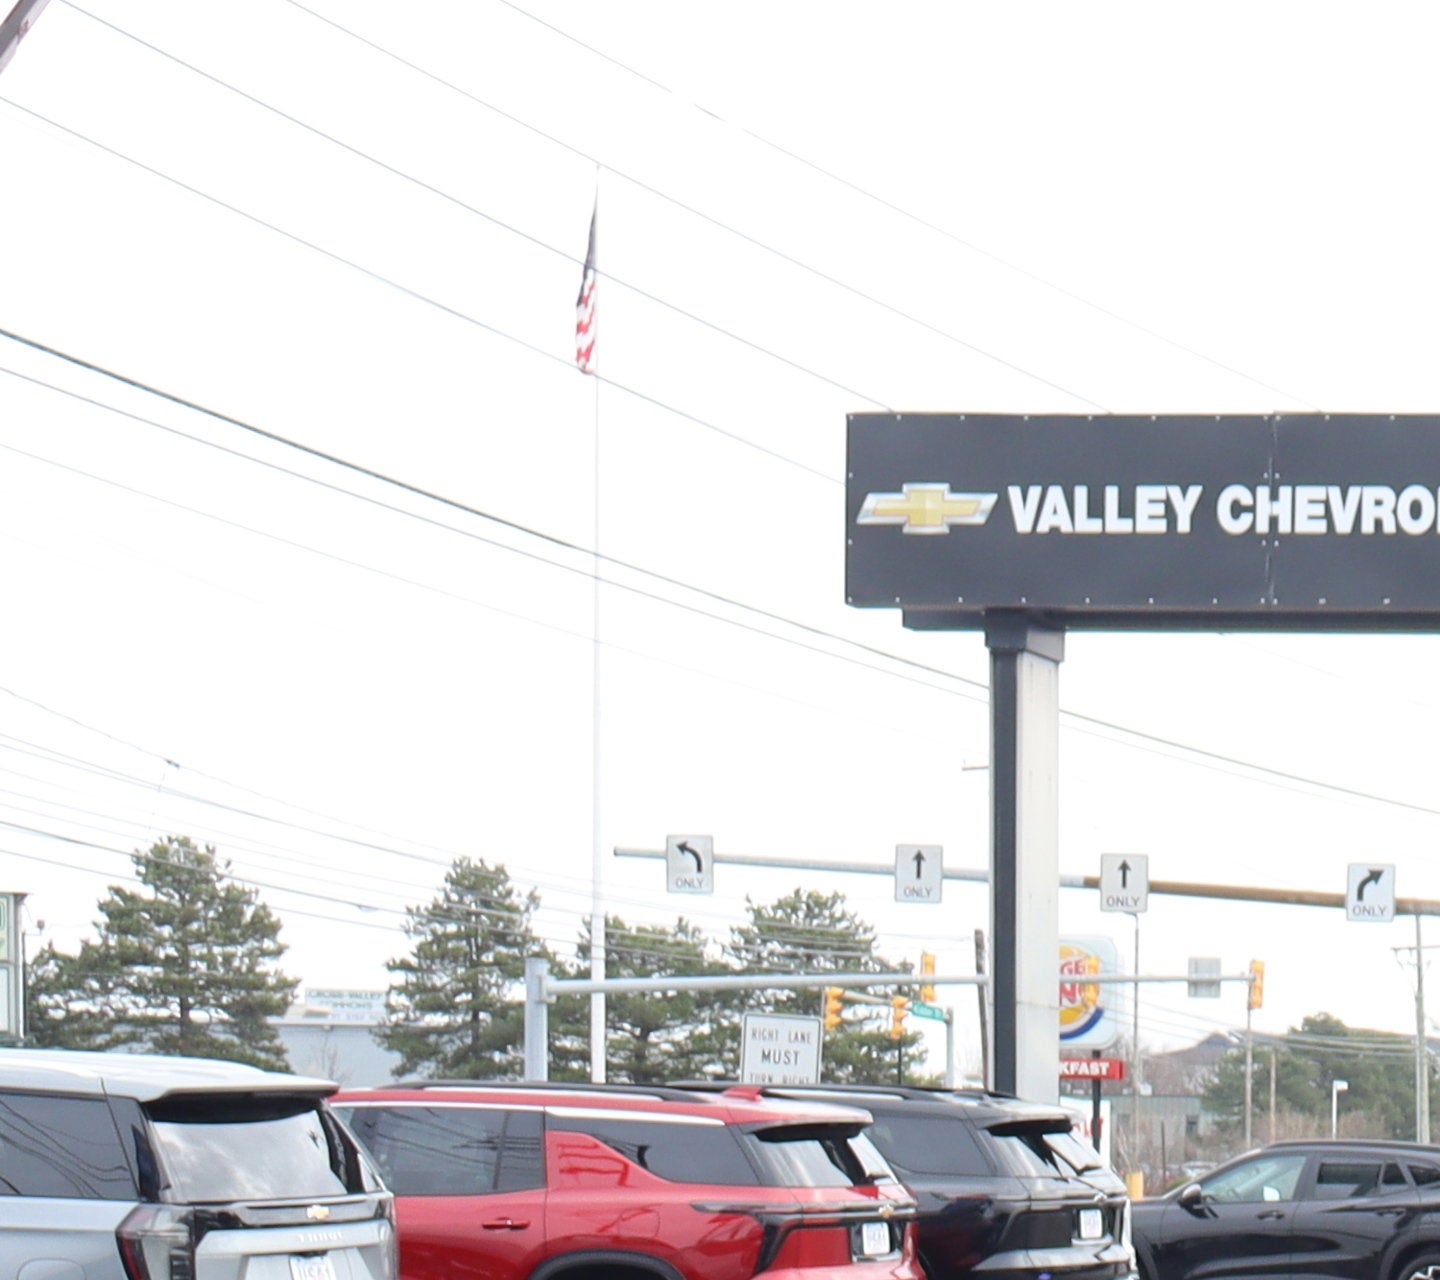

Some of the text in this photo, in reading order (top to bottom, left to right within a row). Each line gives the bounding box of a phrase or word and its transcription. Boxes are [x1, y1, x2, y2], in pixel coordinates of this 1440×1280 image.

[1008, 485, 1203, 534] VALLEY
[675, 878, 704, 889] ONLY
[903, 886, 933, 898] ONLY
[1106, 896, 1140, 907] ONLY
[1352, 905, 1388, 916] ONLY
[751, 1027, 812, 1043] RIGHT LANE
[761, 1049, 800, 1066] MUST
